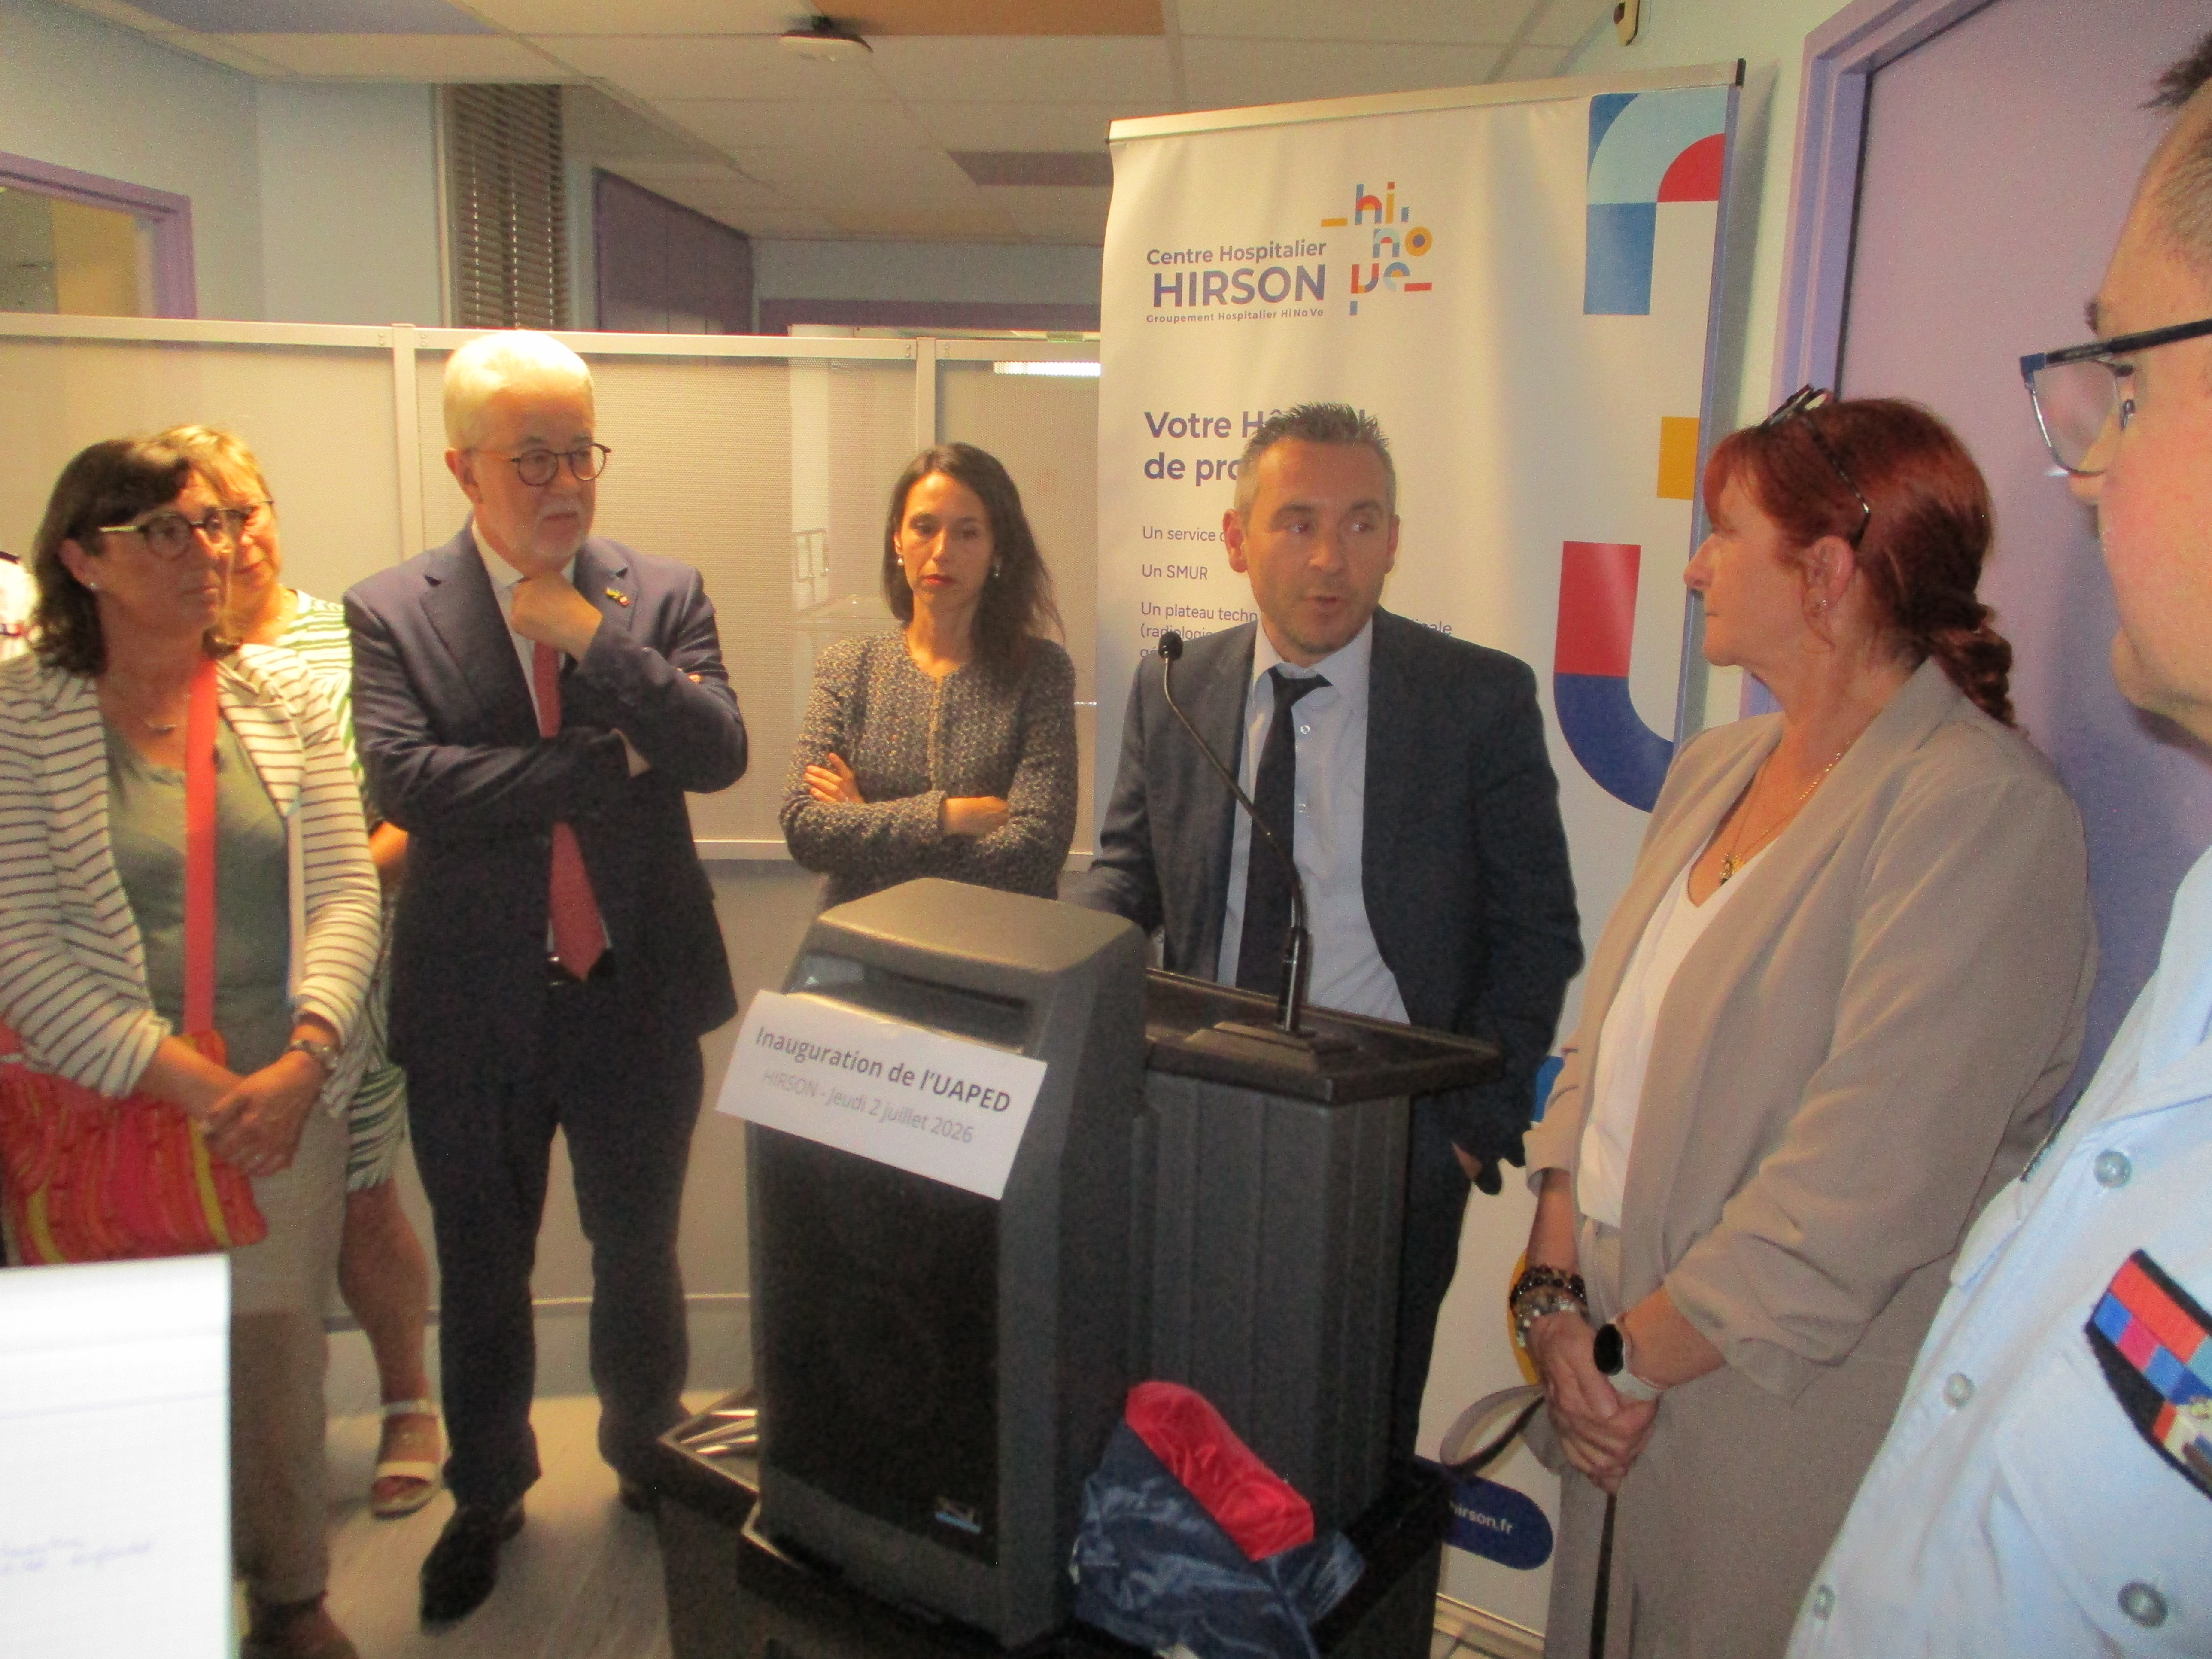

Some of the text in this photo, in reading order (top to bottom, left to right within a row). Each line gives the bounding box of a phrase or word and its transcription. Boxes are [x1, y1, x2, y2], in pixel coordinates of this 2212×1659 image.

[1146, 238, 1326, 265] Centre Hospitalier
[1153, 264, 1326, 308] HIRSON
[1146, 314, 1214, 324] Groupement
[1218, 310, 1277, 321] Hospitalier
[1144, 411, 1231, 438] Votre
[1144, 452, 1186, 480] de
[1143, 526, 1163, 539] Un
[1167, 528, 1216, 541] service
[1142, 564, 1208, 580] Un SMUR
[1141, 602, 1161, 615] Un
[1166, 604, 1214, 619] plateau
[756, 1027, 883, 1078] Inauguration
[888, 1062, 915, 1087] de
[868, 1097, 882, 1117] 2
[878, 1100, 928, 1131] juillet
[930, 1116, 975, 1144] 2026
